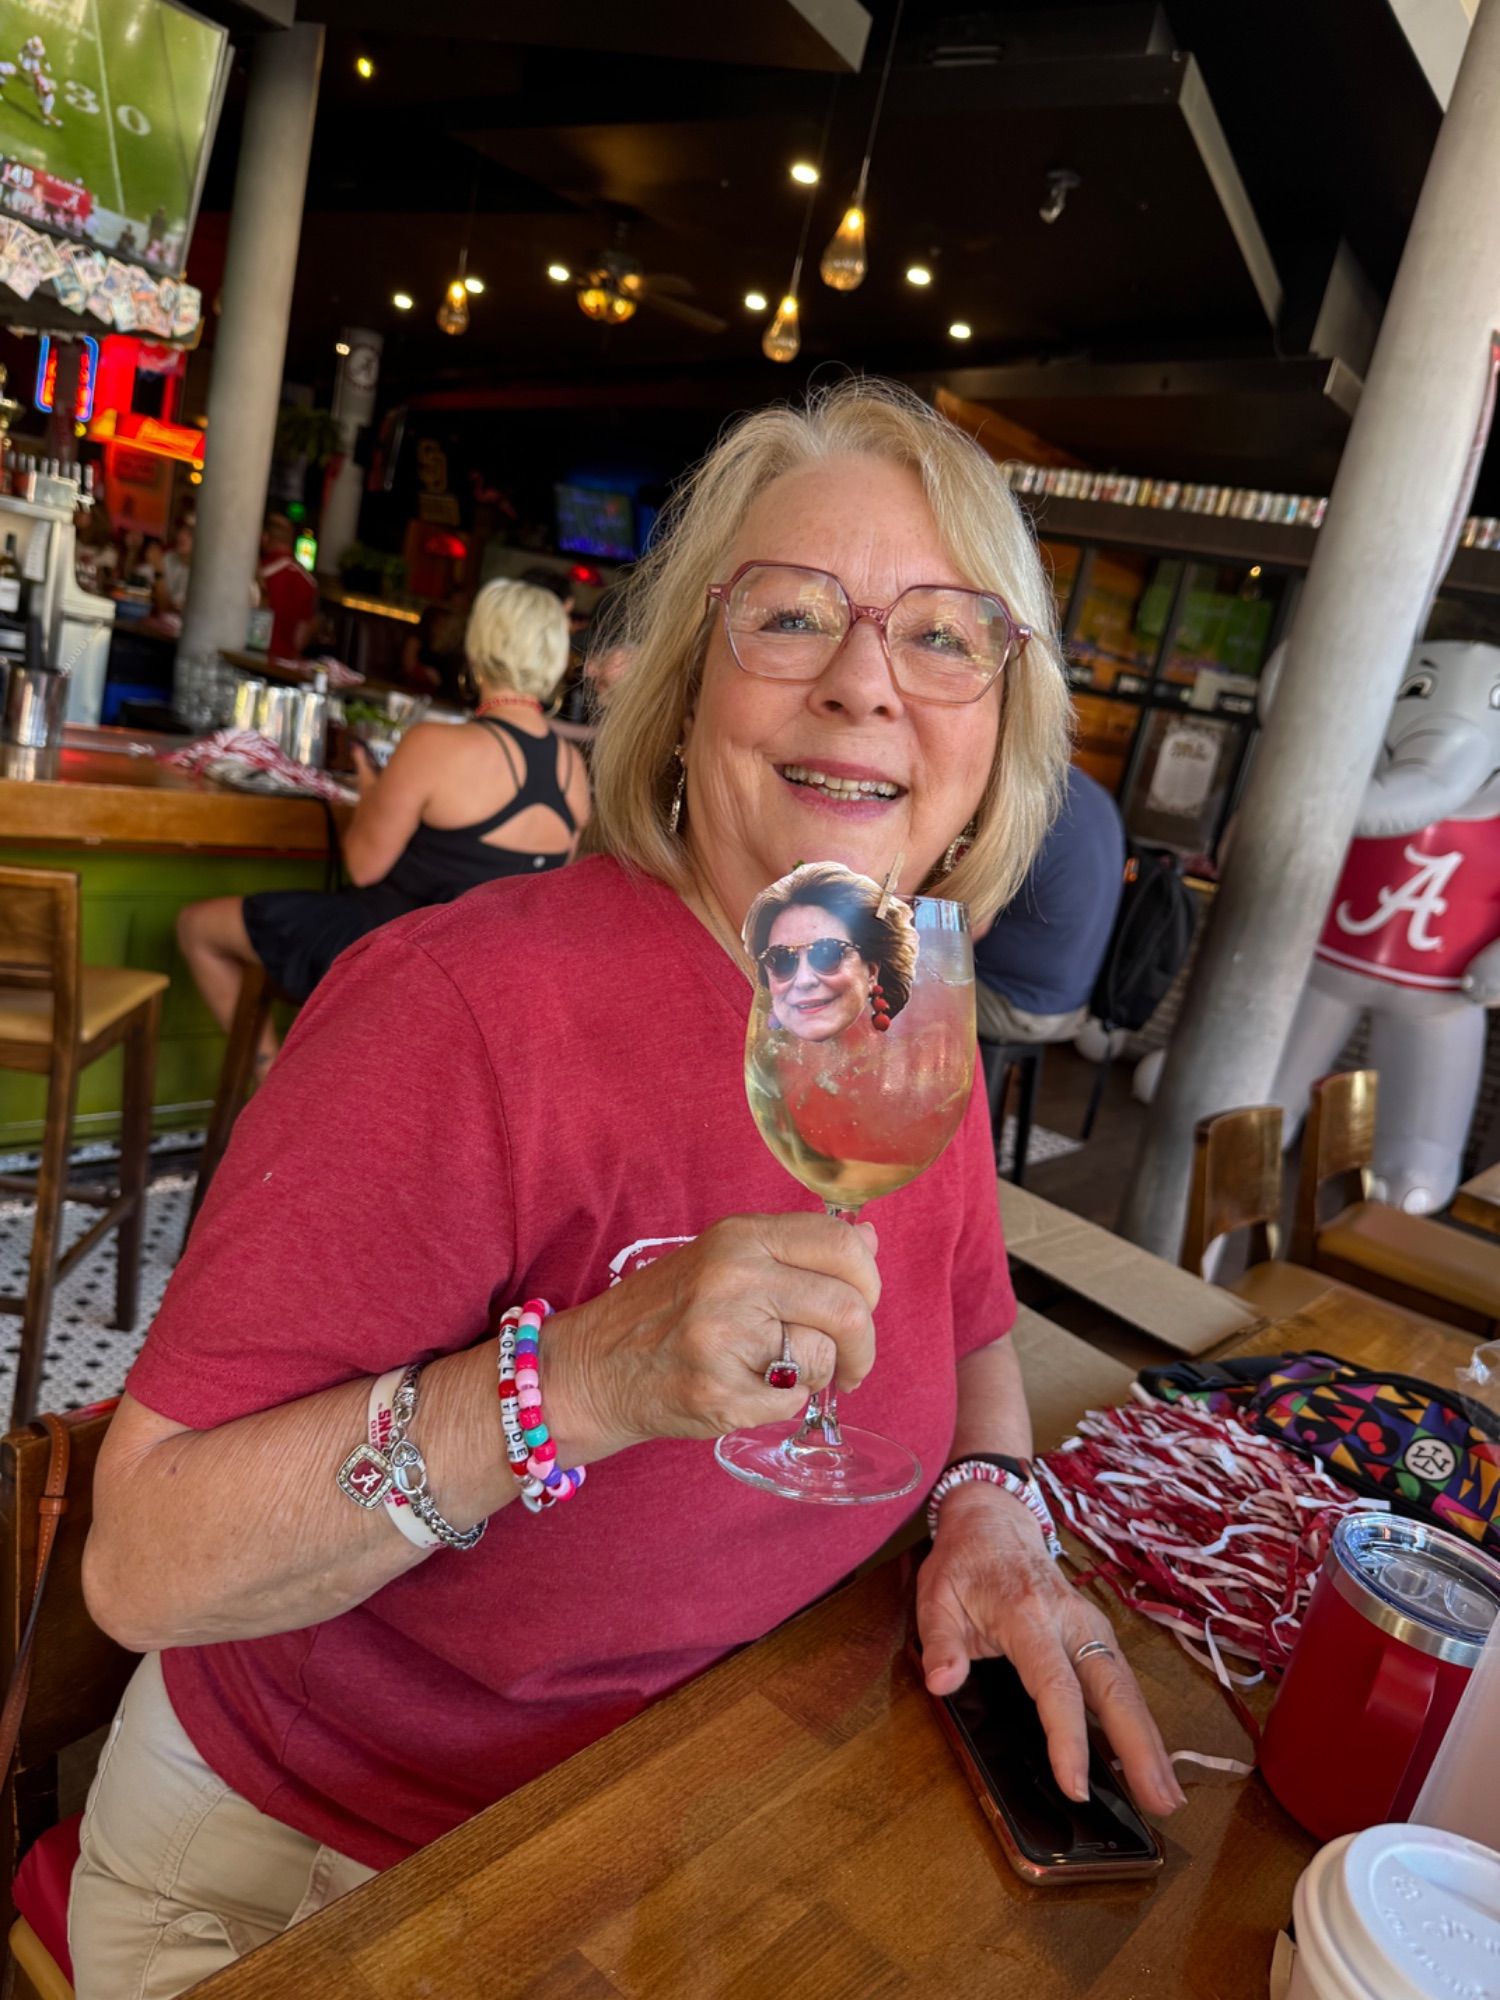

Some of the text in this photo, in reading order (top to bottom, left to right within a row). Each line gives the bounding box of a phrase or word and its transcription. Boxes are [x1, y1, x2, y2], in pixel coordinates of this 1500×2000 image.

[1336, 843, 1464, 952] A
[503, 1401, 529, 1459] TIDE
[350, 1467, 382, 1495] A
